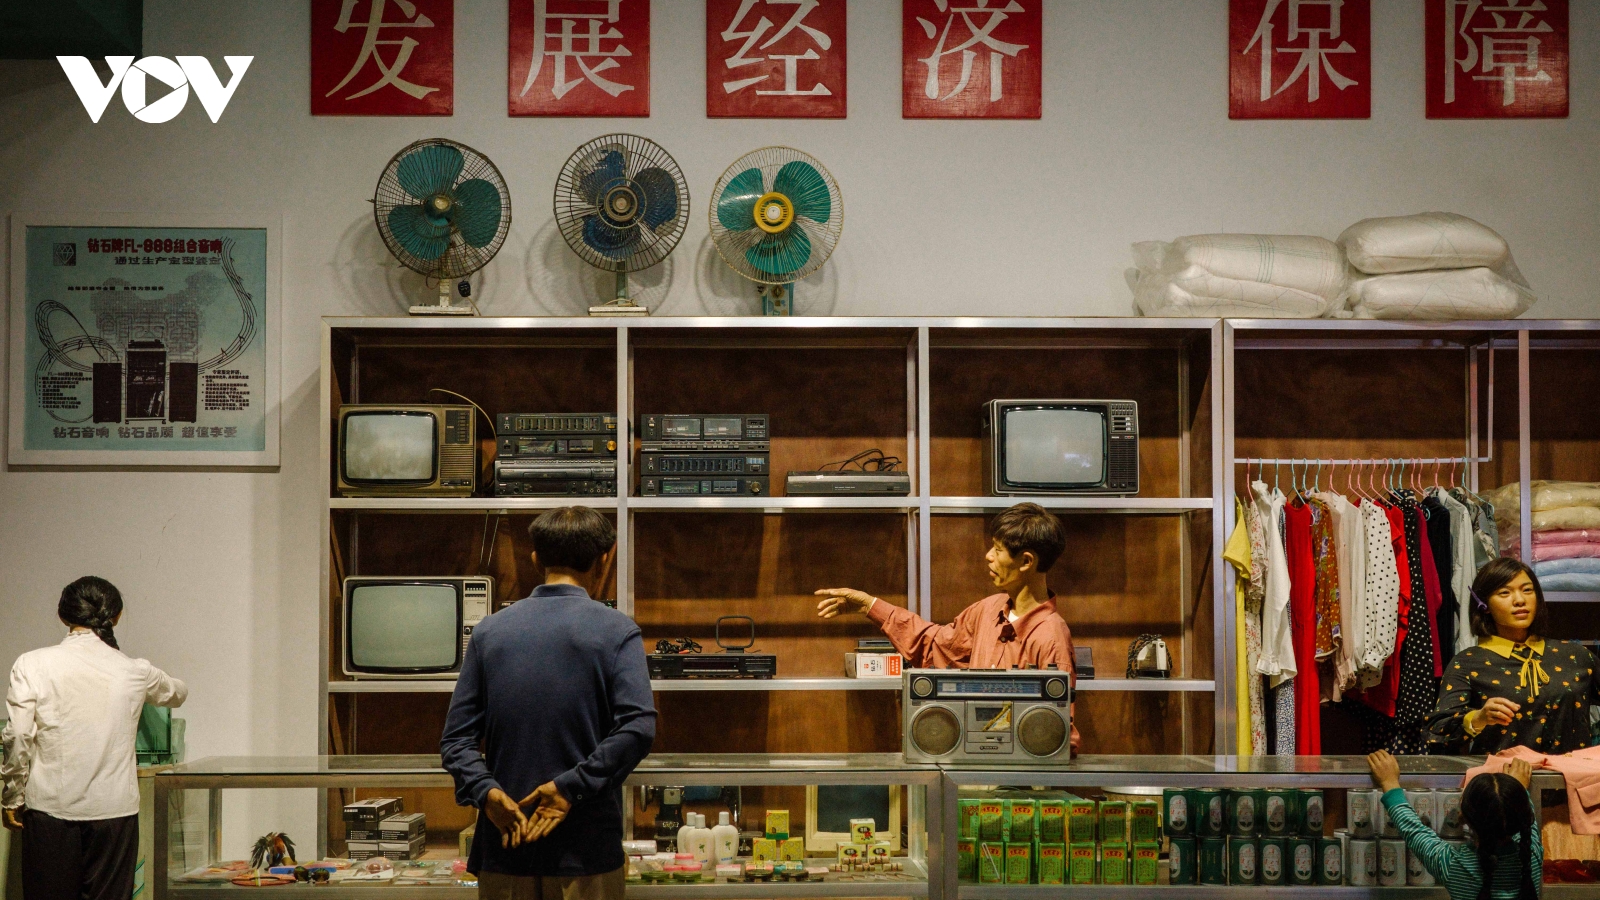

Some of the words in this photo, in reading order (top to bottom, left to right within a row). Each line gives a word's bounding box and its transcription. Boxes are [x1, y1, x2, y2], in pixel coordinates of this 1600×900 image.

[53, 426, 110, 439] 钻石音响
[118, 426, 174, 439] 钻石品质
[181, 426, 238, 439] 超值享受
